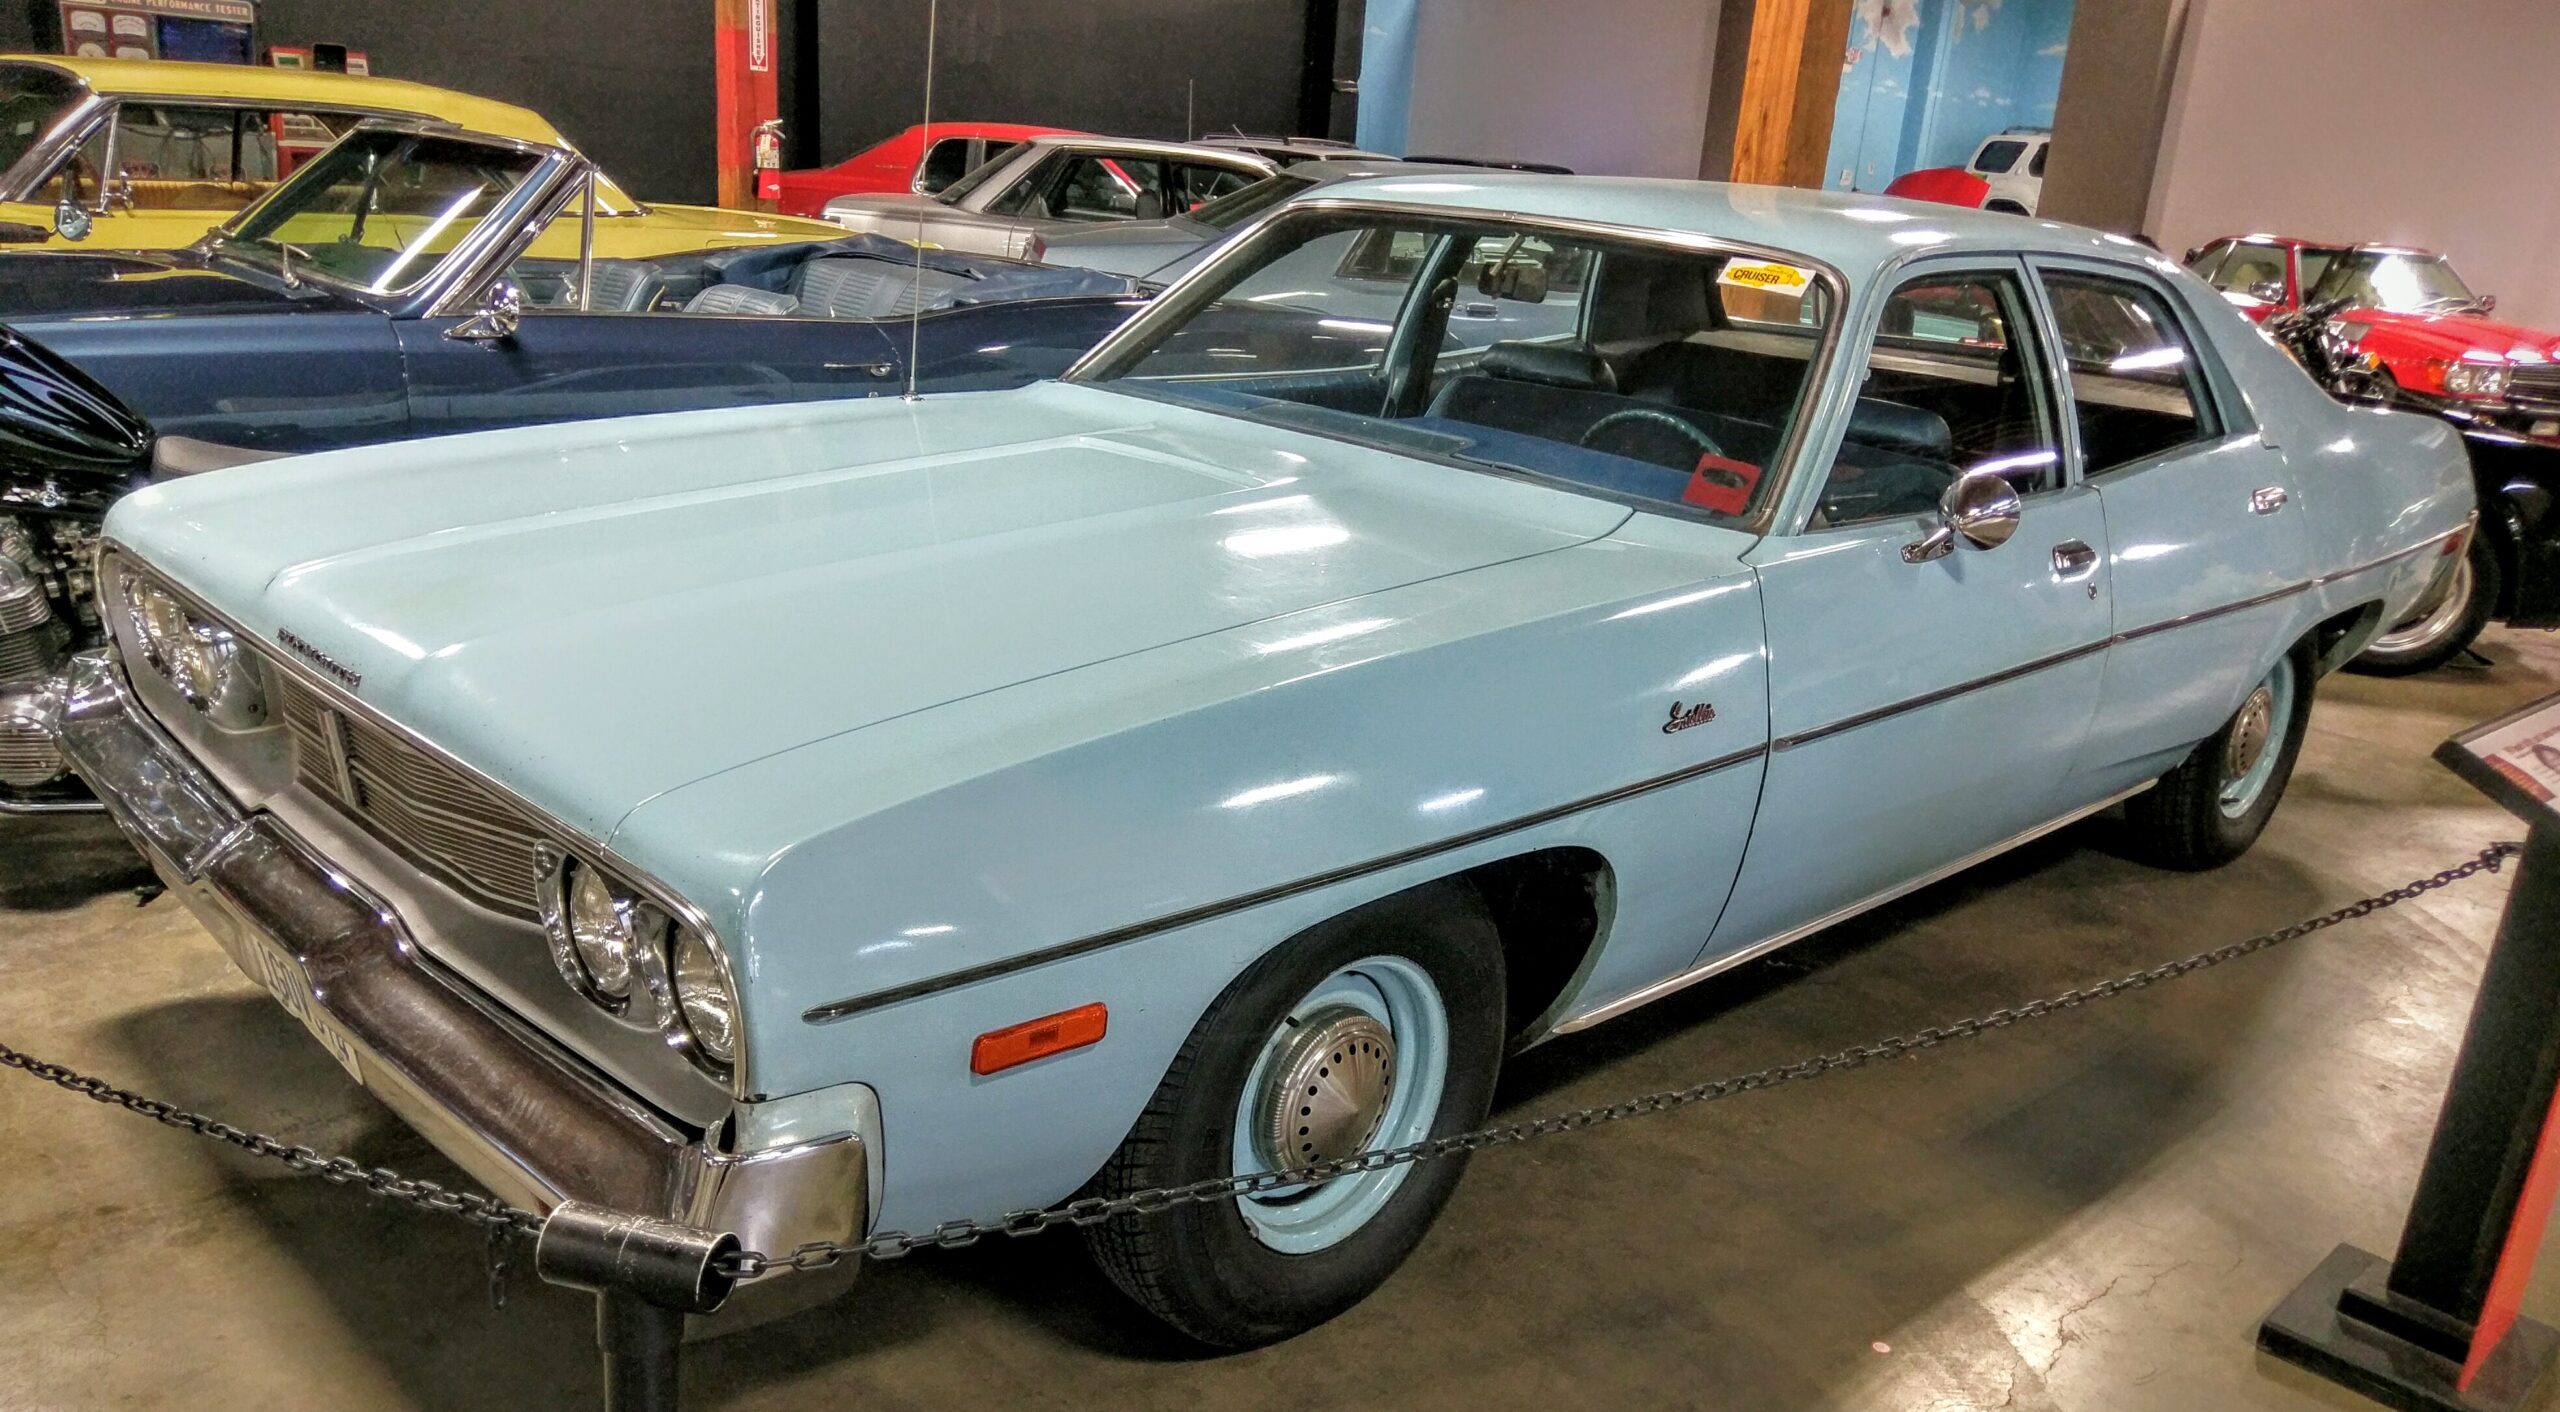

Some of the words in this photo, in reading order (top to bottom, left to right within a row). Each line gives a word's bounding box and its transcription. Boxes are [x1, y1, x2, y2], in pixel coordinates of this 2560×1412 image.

[146, 0, 211, 13] PERFORMANCE
[215, 4, 248, 16] TESTER
[1733, 269, 1780, 284] CRUISER
